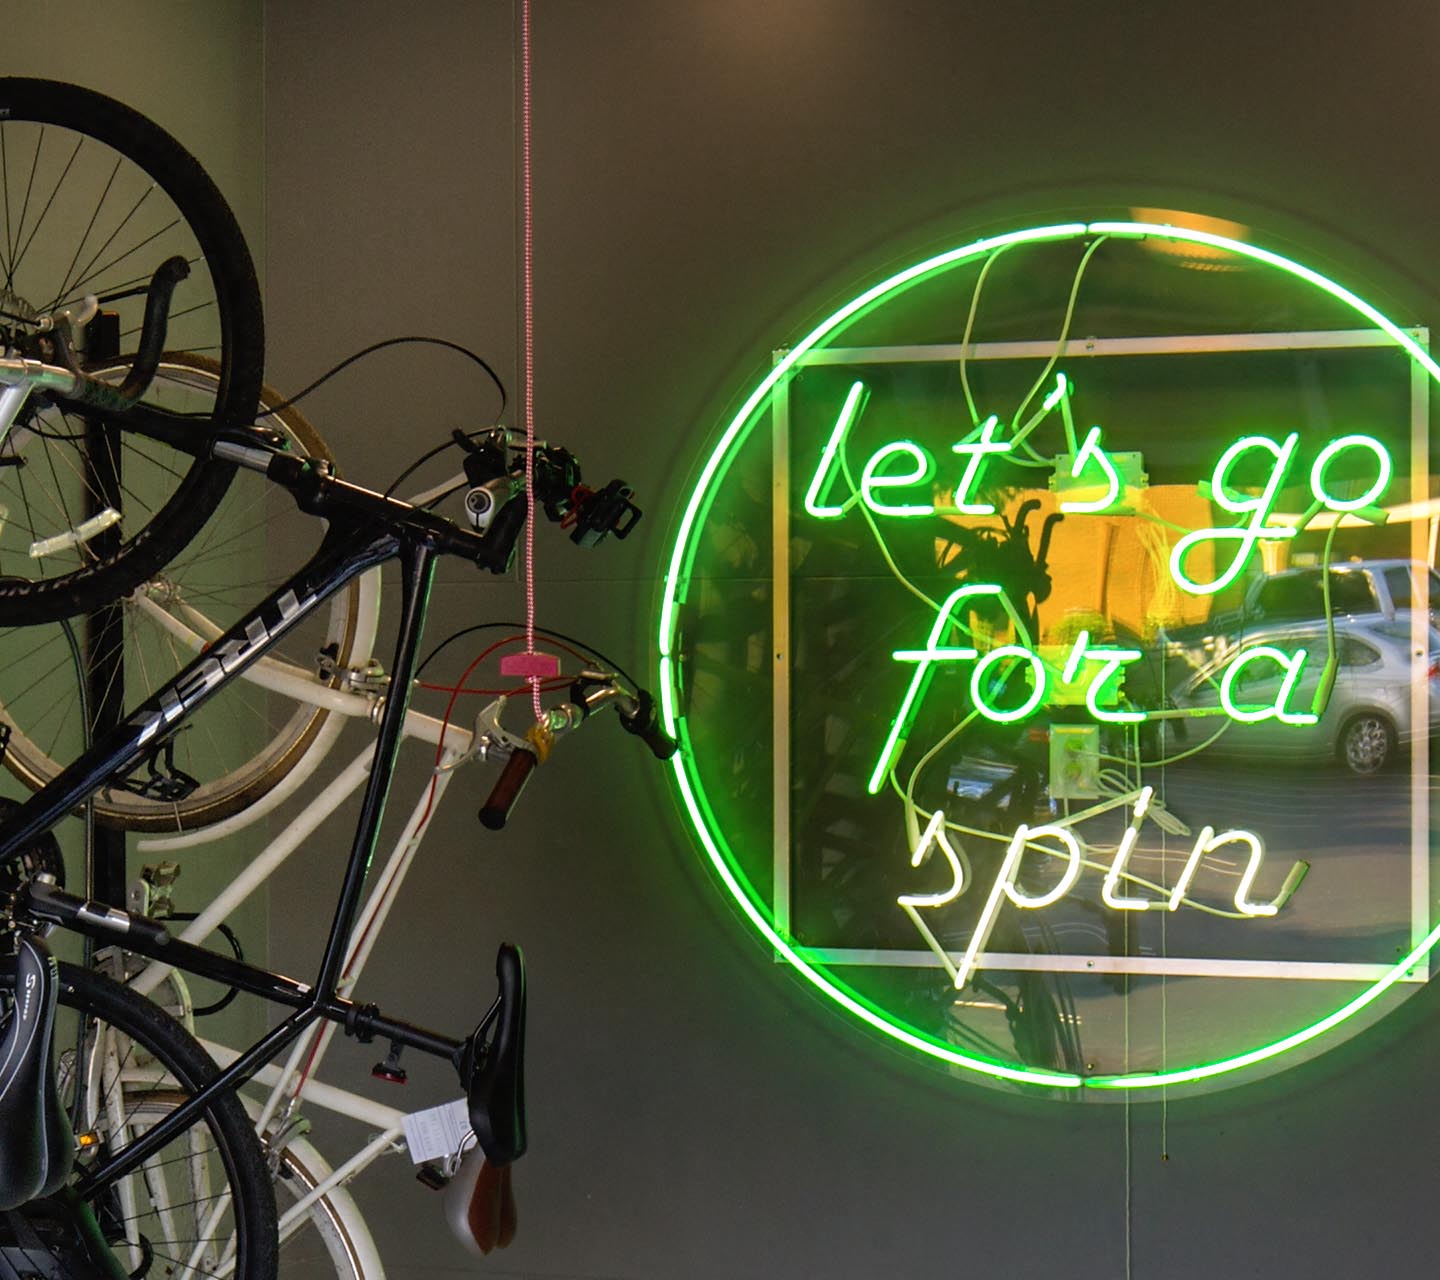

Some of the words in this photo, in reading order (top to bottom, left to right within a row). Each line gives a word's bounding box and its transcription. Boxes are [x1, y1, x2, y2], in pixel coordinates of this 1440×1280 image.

[804, 372, 1122, 520] let's
[1169, 431, 1393, 596] go
[127, 586, 319, 748] TREK
[867, 584, 1148, 794] for
[1219, 645, 1320, 725] a
[896, 786, 1280, 990] spin
